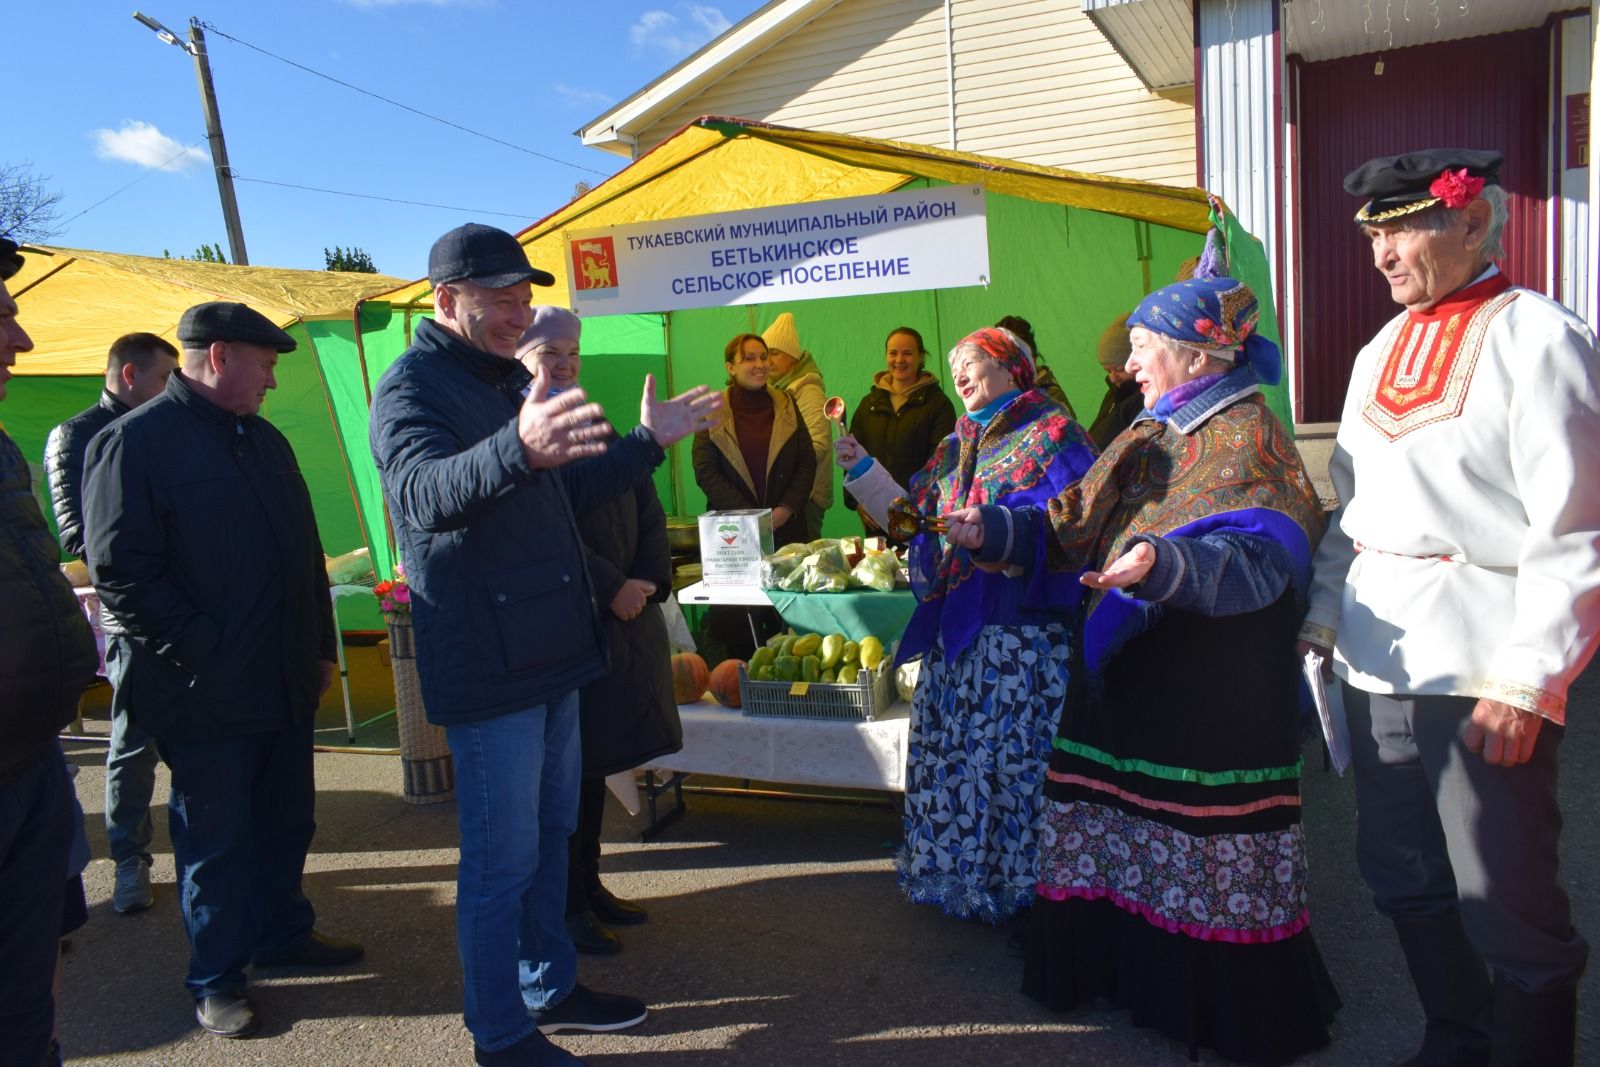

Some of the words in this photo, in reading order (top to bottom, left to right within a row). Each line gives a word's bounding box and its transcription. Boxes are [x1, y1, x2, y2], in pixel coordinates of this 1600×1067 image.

[626, 223, 726, 251] ТУКАЕВСКИЙ
[729, 206, 888, 239] МУНИЦИПАЛЬНЫЙ
[893, 200, 956, 222] РАЙОН
[711, 236, 859, 267] БЕТЬКИНСКОЕ
[671, 269, 775, 296] СЕЛЬСКОЕ
[779, 256, 911, 285] ПОСЕЛЕНИЕ
